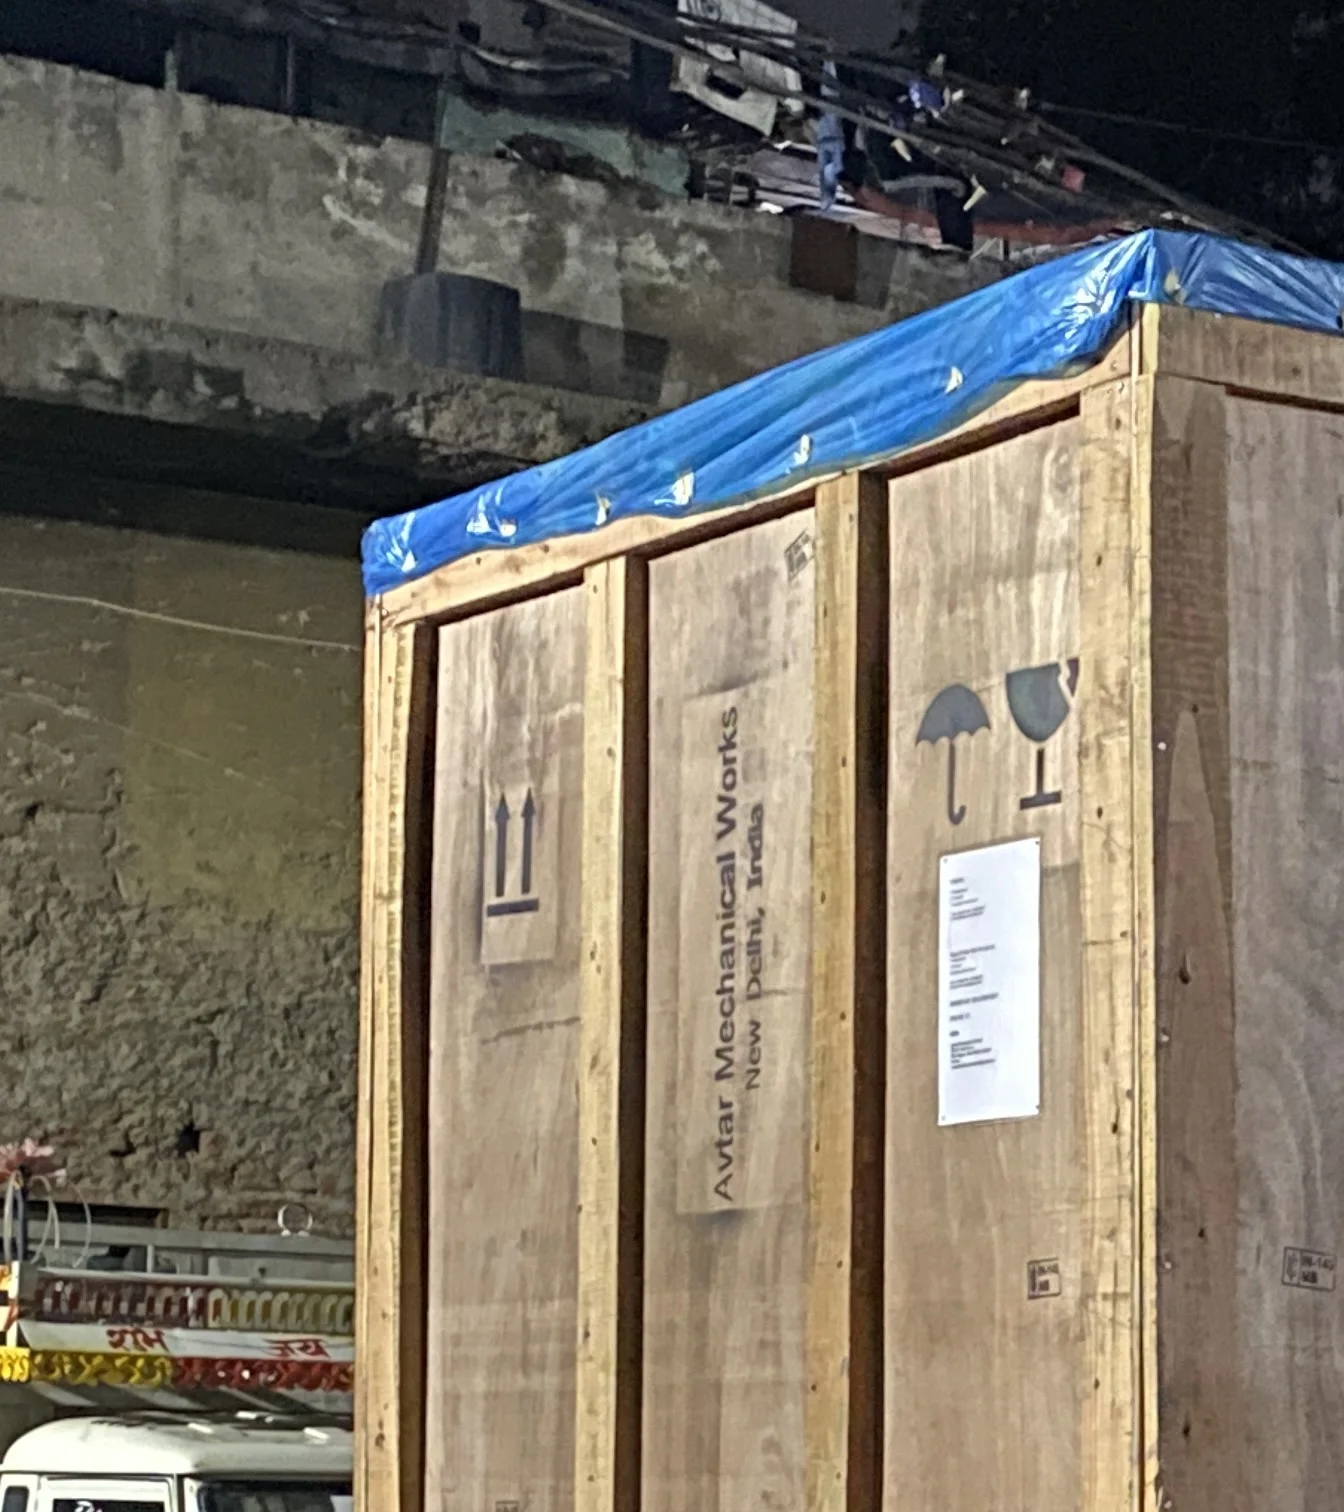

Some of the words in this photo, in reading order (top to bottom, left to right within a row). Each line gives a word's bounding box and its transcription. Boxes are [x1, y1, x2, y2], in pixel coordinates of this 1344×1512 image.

[715, 705, 739, 842] Works
[747, 802, 765, 891] India
[713, 851, 737, 1082] Mechanical
[745, 906, 766, 1001] Delhi,
[745, 1019, 762, 1091] New
[713, 1095, 735, 1202] Avtar
